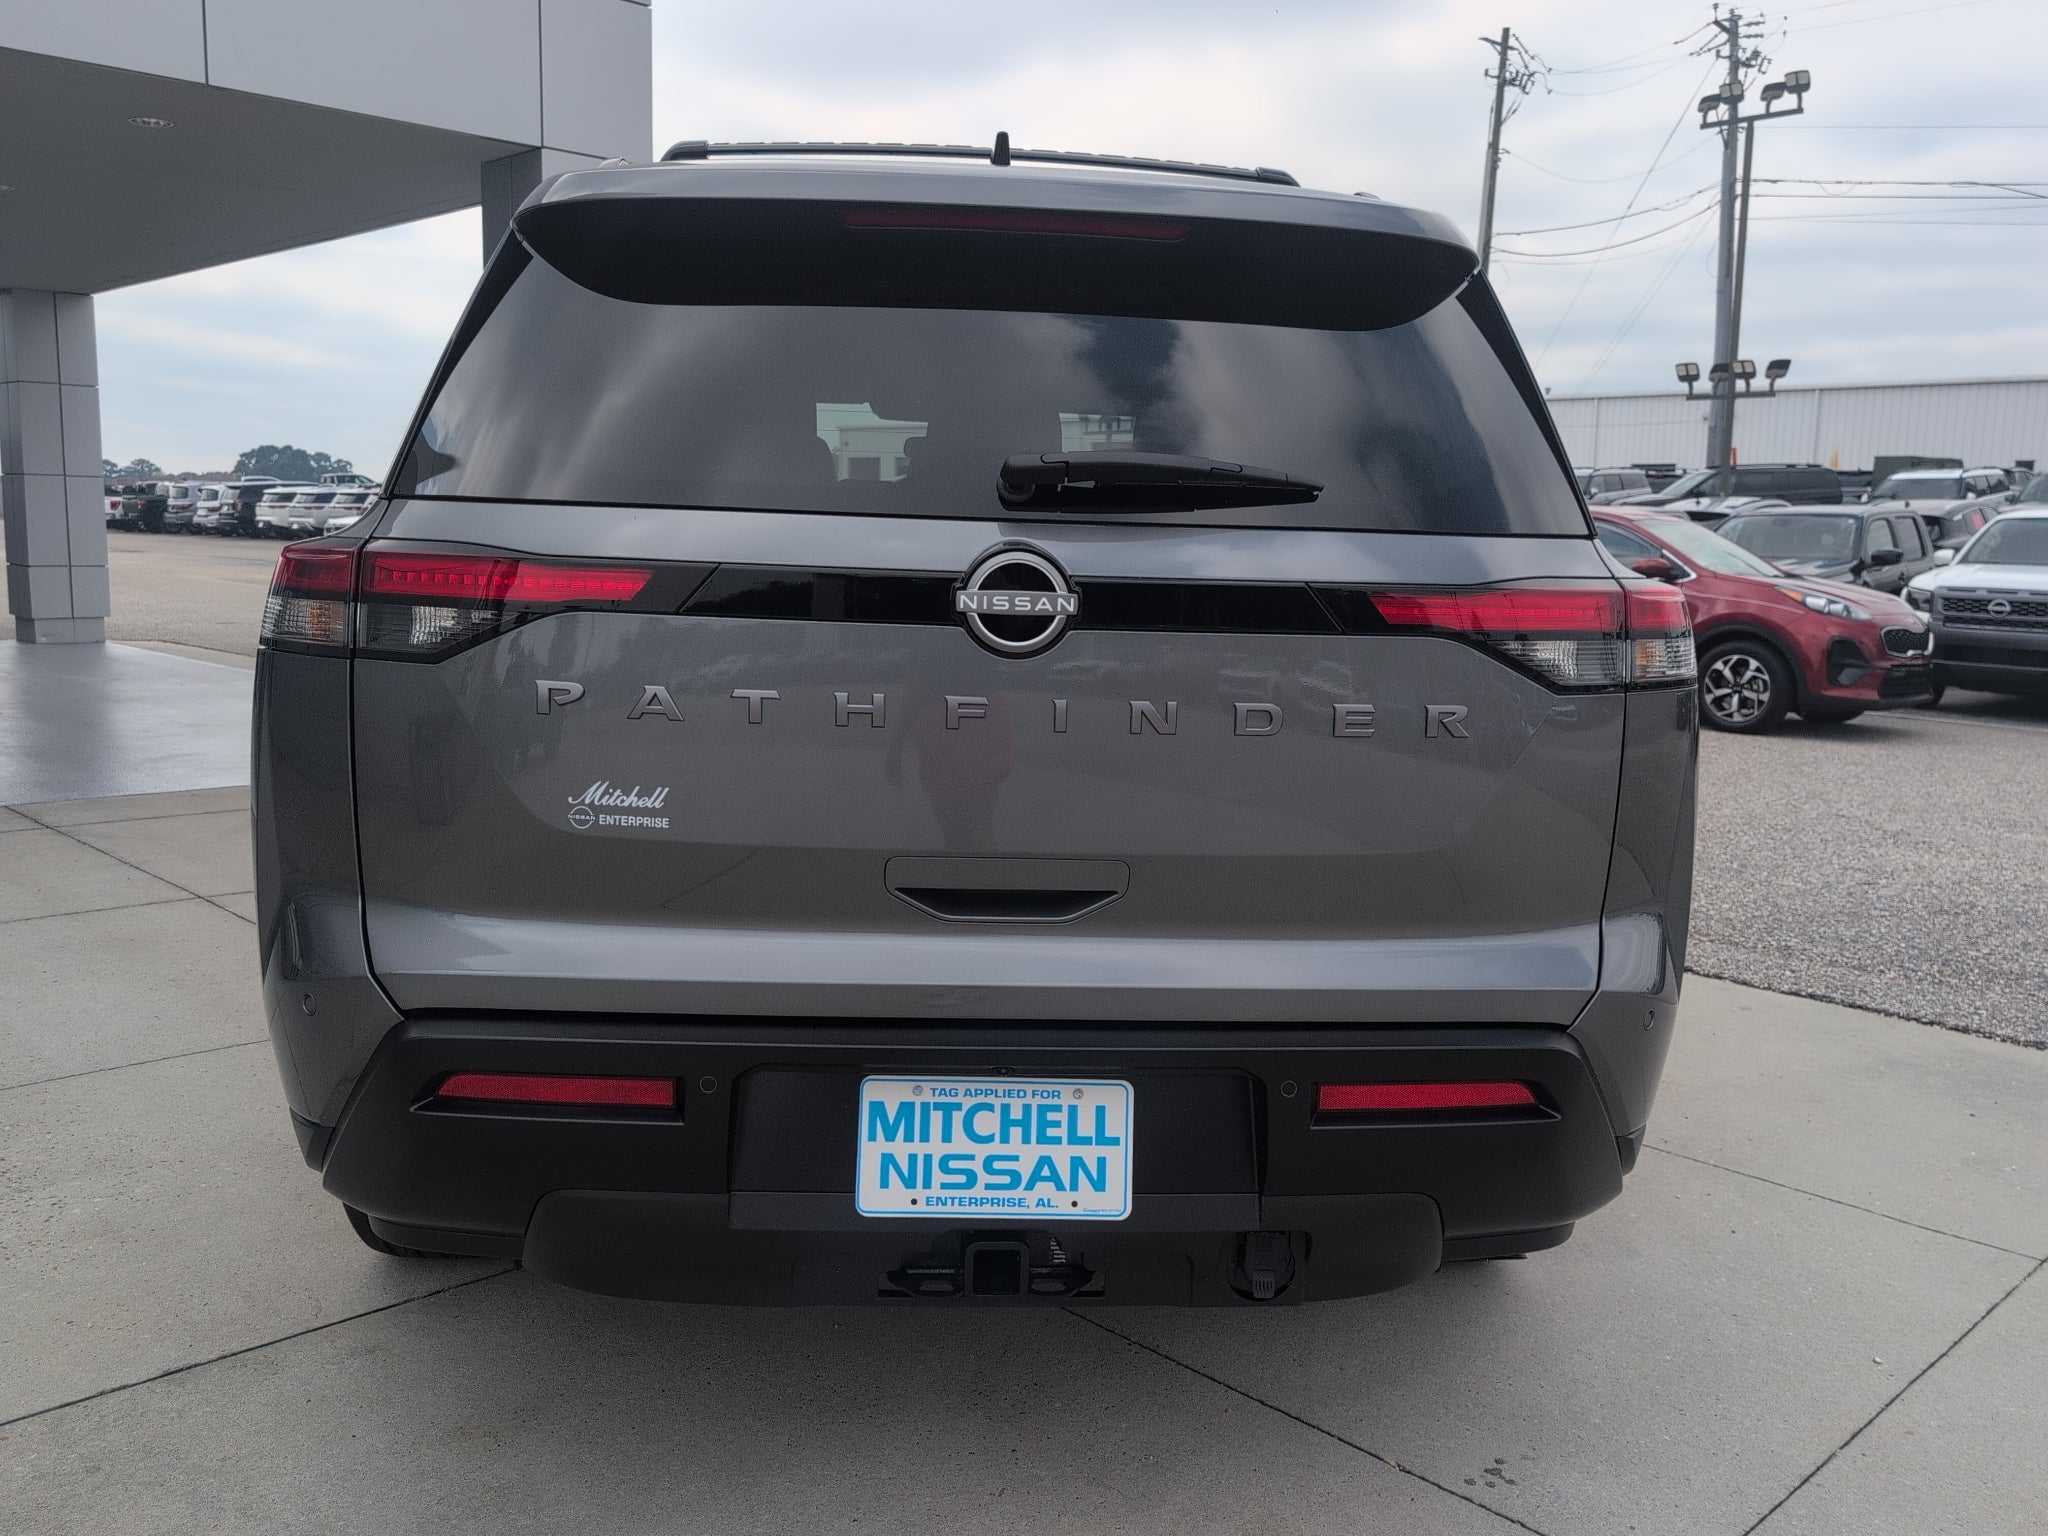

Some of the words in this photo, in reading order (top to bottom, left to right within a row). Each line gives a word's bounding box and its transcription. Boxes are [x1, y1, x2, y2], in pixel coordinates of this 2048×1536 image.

[959, 594, 1075, 612] NISSAN
[534, 679, 1470, 738] PATHFINDER
[567, 780, 670, 809] Mitchell
[598, 814, 670, 829] ENTERPRISE
[929, 1087, 959, 1098] TAG
[963, 1088, 1027, 1099] APPLIED
[1031, 1089, 1062, 1100] FOR
[867, 1100, 1121, 1147] MITCHELL
[879, 1152, 1107, 1193] NISSAN
[925, 1196, 1030, 1209] ENTERPRISE,
[1035, 1198, 1059, 1208] AL.
